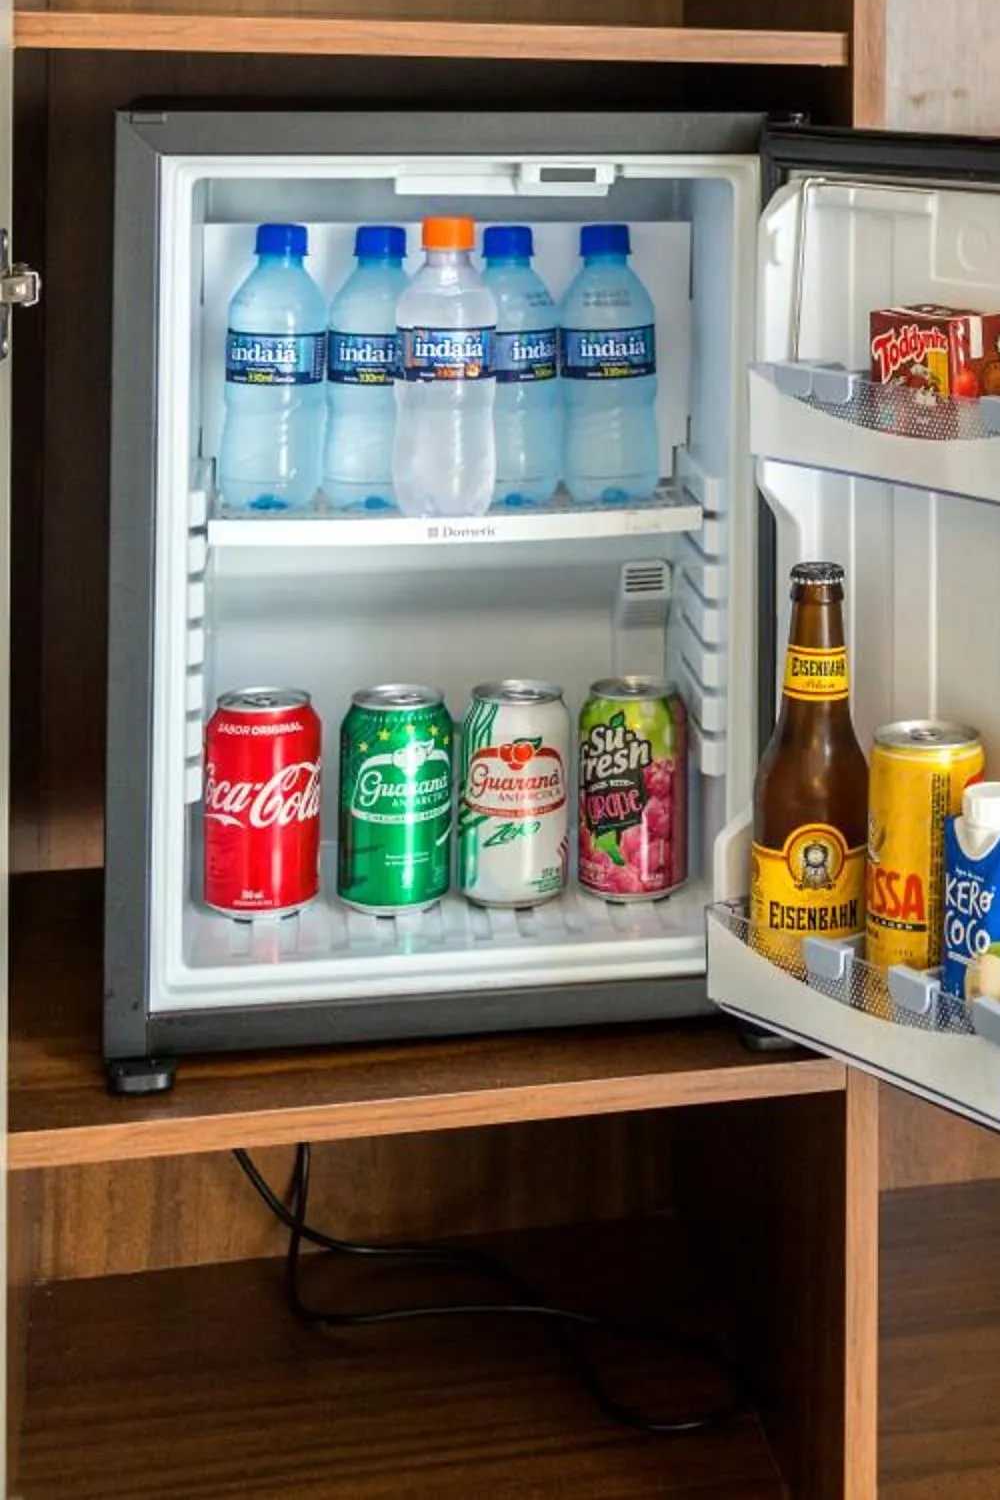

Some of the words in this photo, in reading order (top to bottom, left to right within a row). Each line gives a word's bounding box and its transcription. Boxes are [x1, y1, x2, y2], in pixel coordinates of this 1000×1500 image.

[339, 342, 396, 363] indai
[415, 338, 483, 357] indaiá
[218, 722, 251, 736] SABOR
[251, 721, 303, 736] ORIGINAL
[470, 763, 560, 798] Guaraná
[769, 899, 857, 932] EISENBAHN
